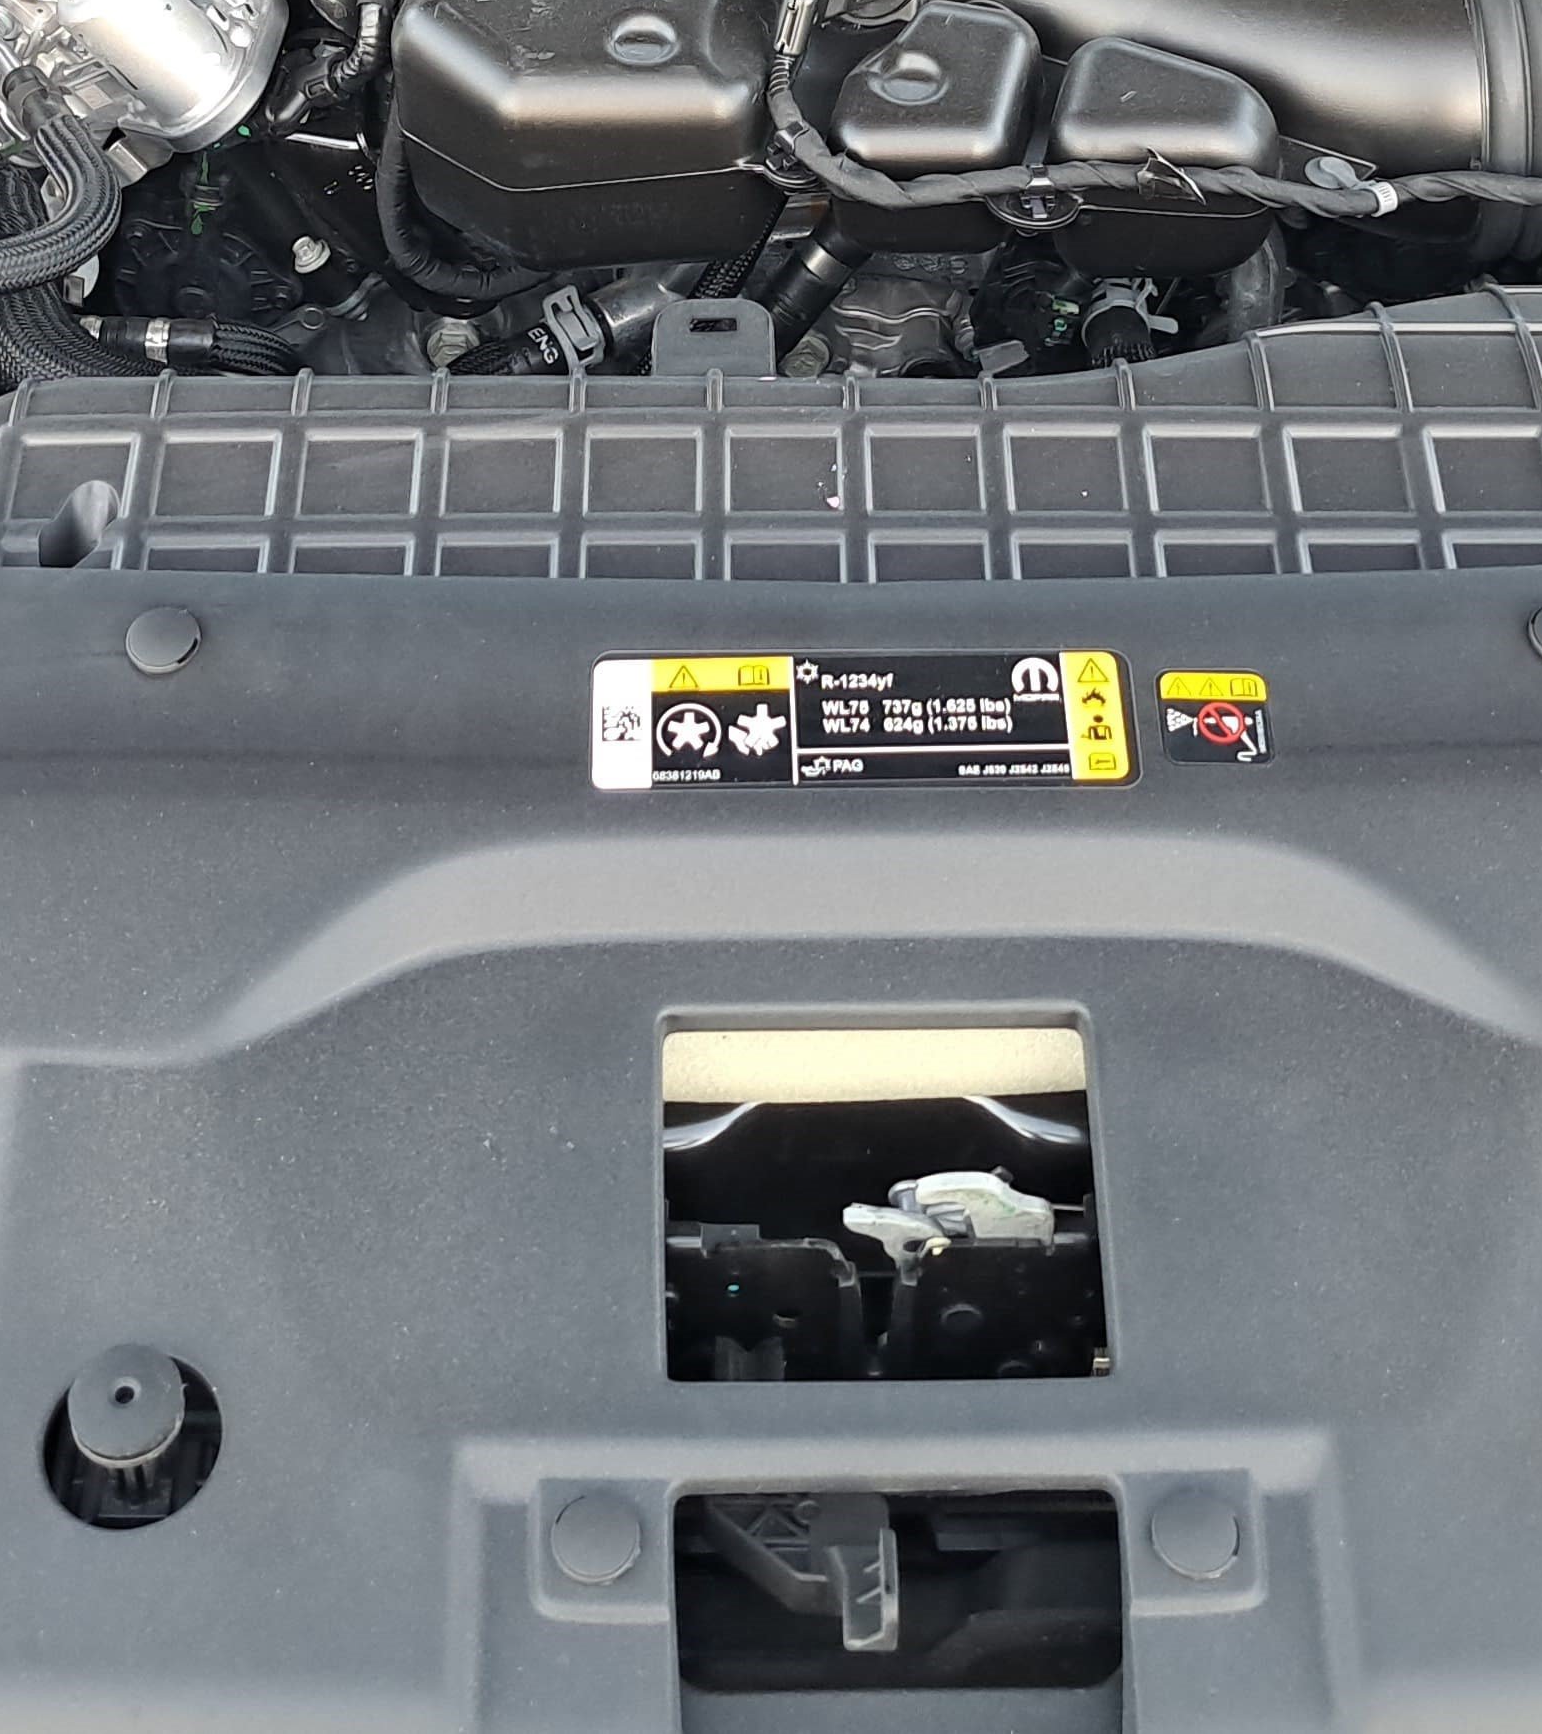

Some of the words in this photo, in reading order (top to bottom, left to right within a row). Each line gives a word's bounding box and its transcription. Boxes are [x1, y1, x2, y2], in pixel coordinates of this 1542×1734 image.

[528, 327, 558, 364] ENG
[821, 673, 894, 691] R-1234yf
[883, 699, 923, 717] 737g
[980, 697, 1011, 716] lbs)
[822, 717, 870, 733] WL74
[981, 715, 1013, 734] lbs)
[832, 758, 864, 774] PAG
